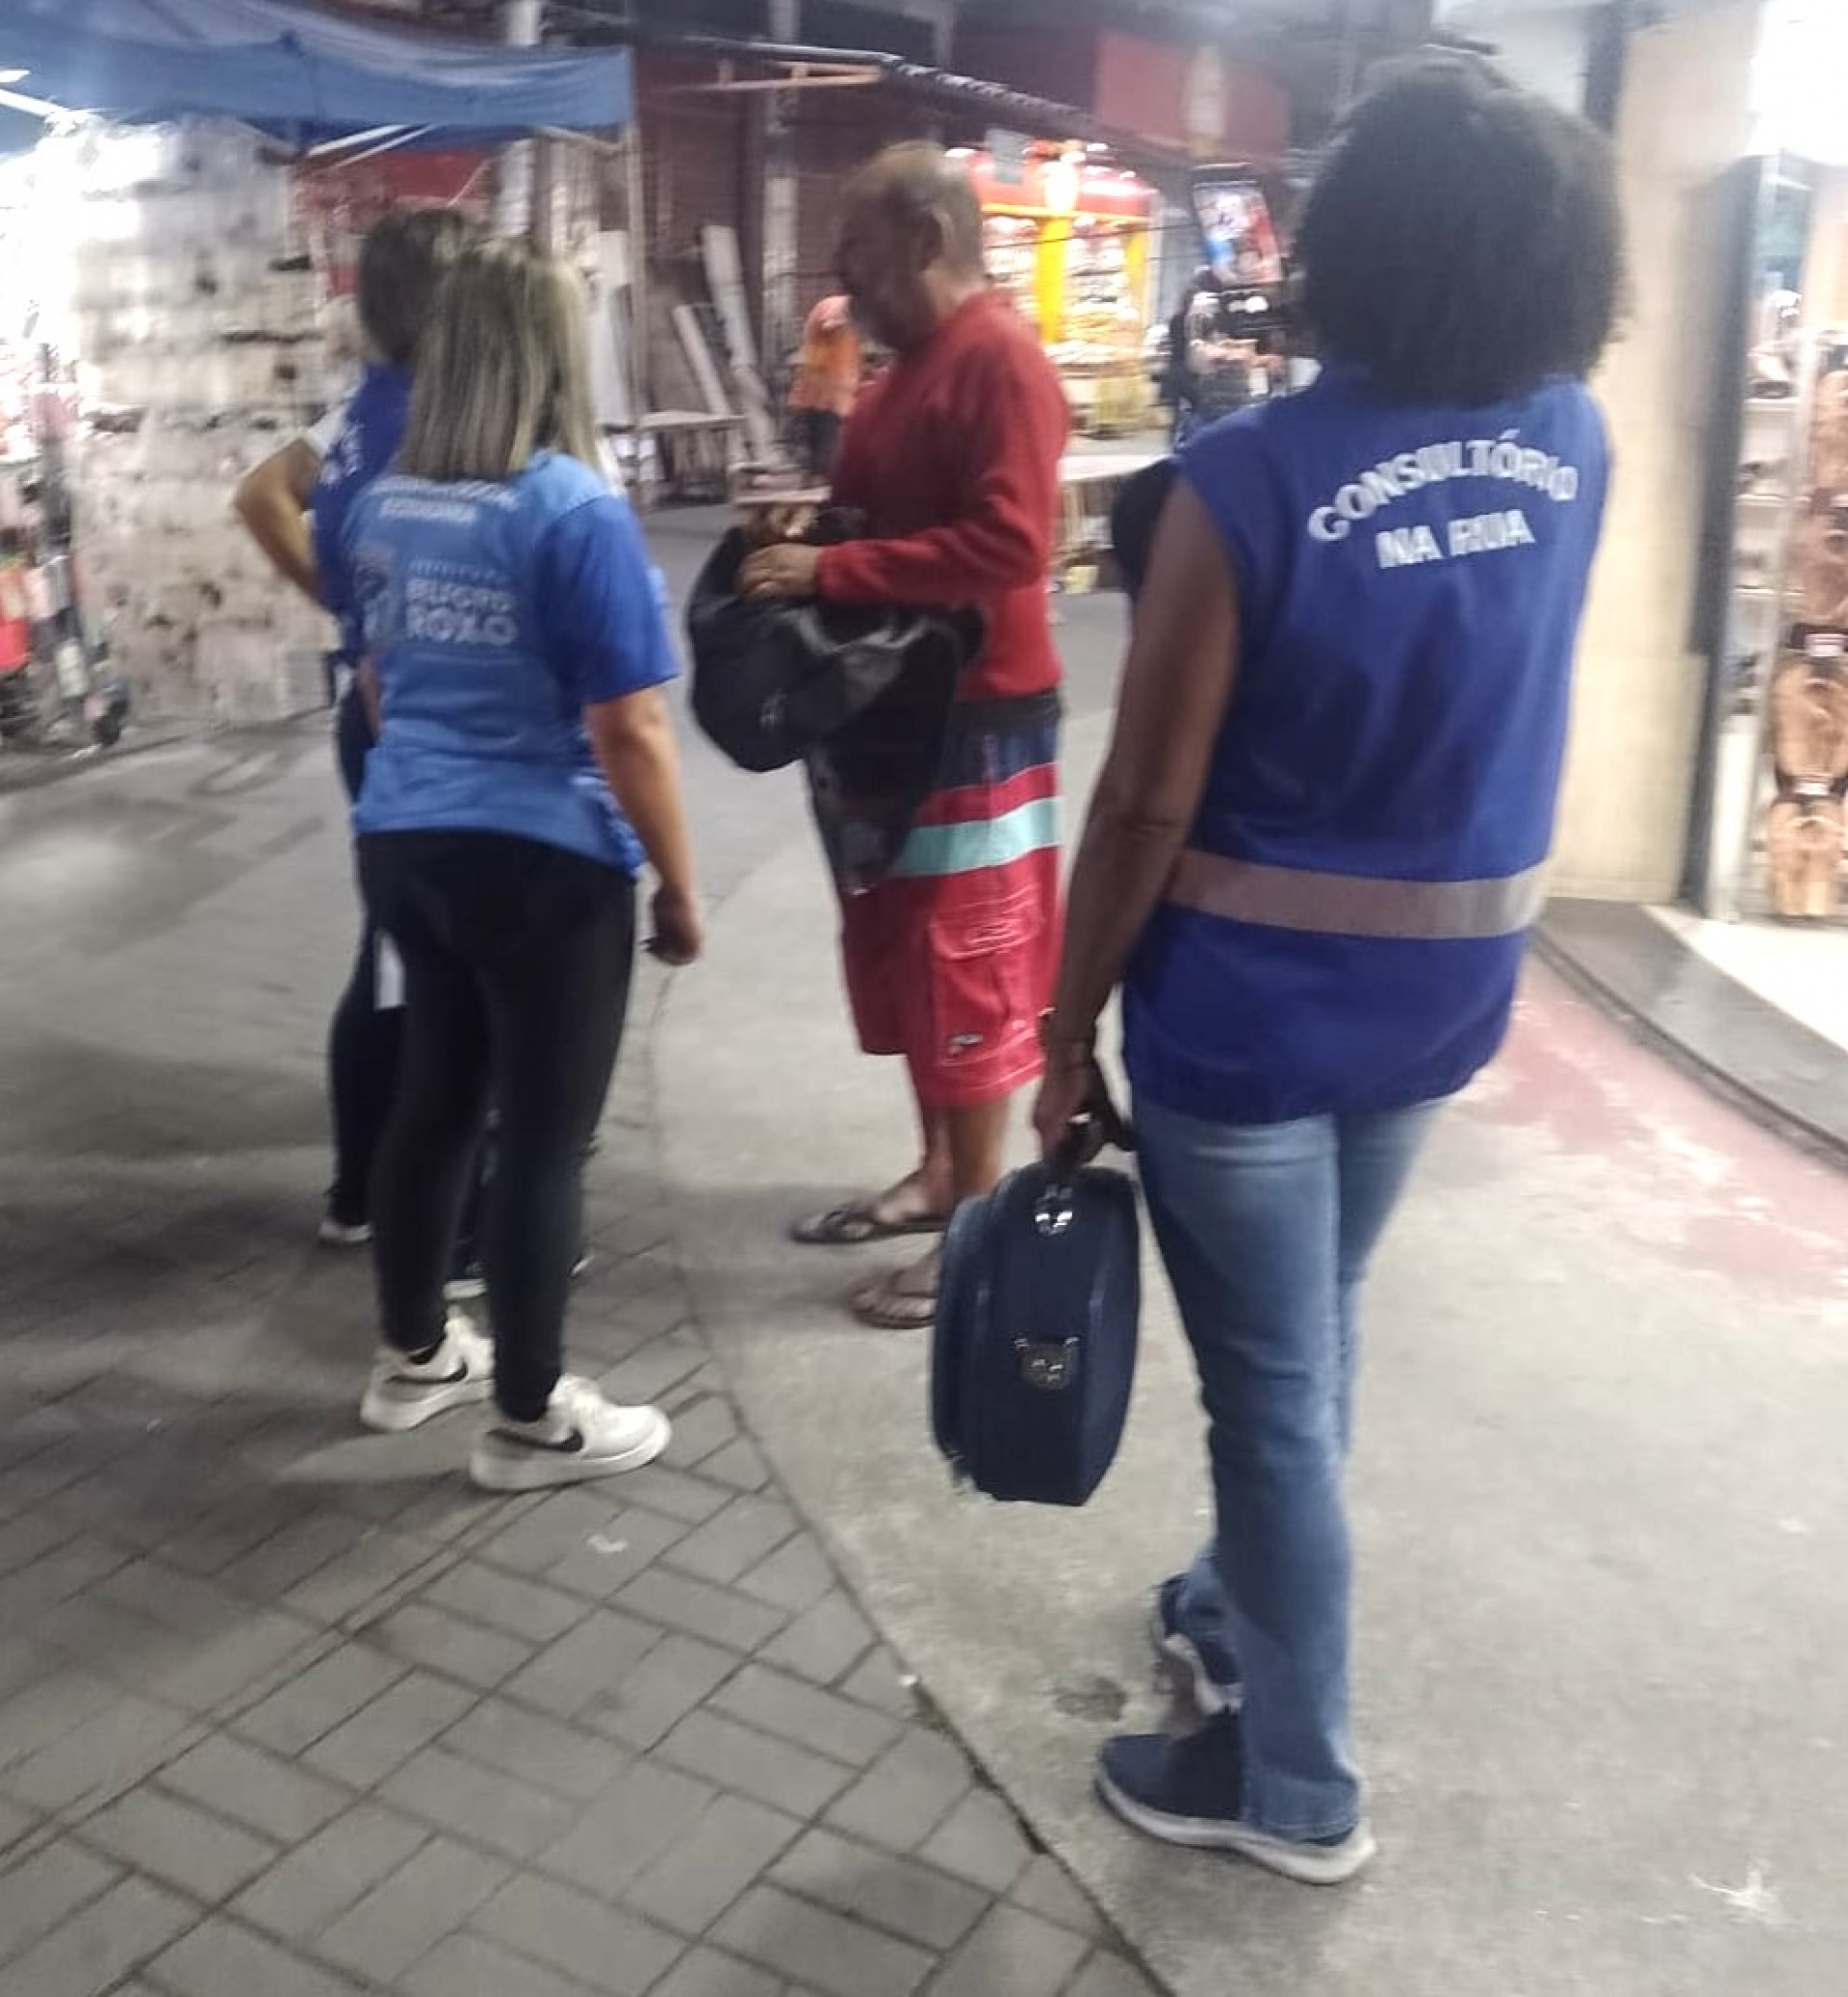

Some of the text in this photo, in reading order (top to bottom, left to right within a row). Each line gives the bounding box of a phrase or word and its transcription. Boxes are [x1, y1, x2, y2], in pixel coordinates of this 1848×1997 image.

[1307, 428, 1578, 542] CONSULTÓRIO
[1375, 508, 1536, 569] NA RUA
